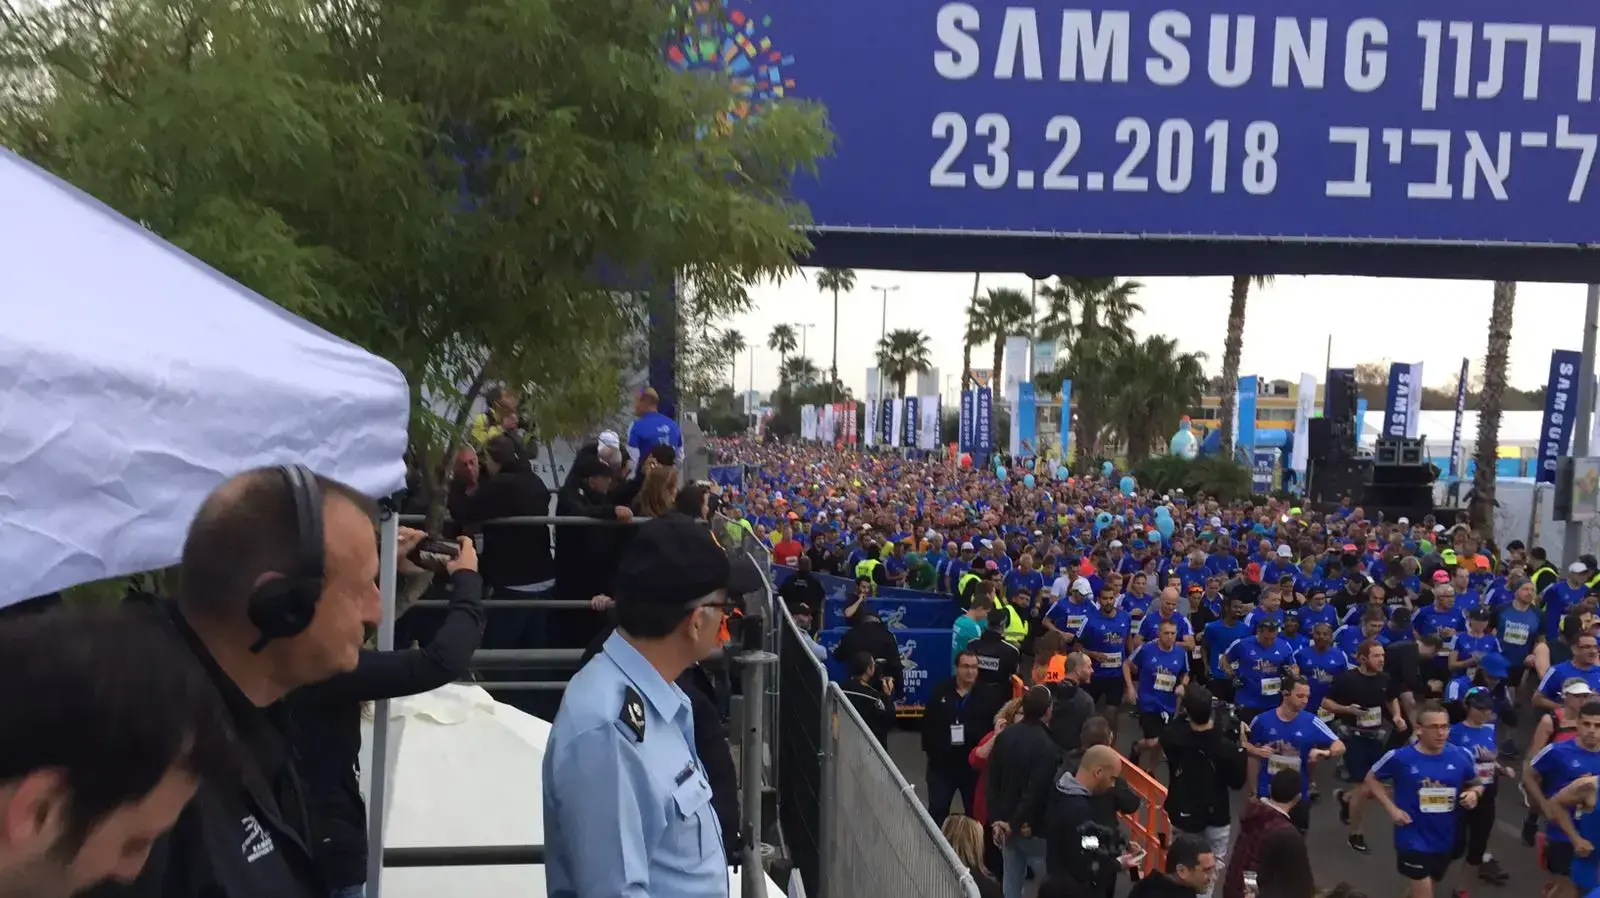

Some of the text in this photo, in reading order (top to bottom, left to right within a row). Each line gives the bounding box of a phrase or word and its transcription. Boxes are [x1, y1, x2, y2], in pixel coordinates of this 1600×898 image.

[933, 2, 1600, 110] רתון SAMSUNG
[930, 111, 1598, 202] ל־אביב 23.2.2018
[979, 393, 989, 448] SAMSUNG
[1389, 373, 1410, 436] SAMSU
[1543, 362, 1574, 471] SAMSUNG
